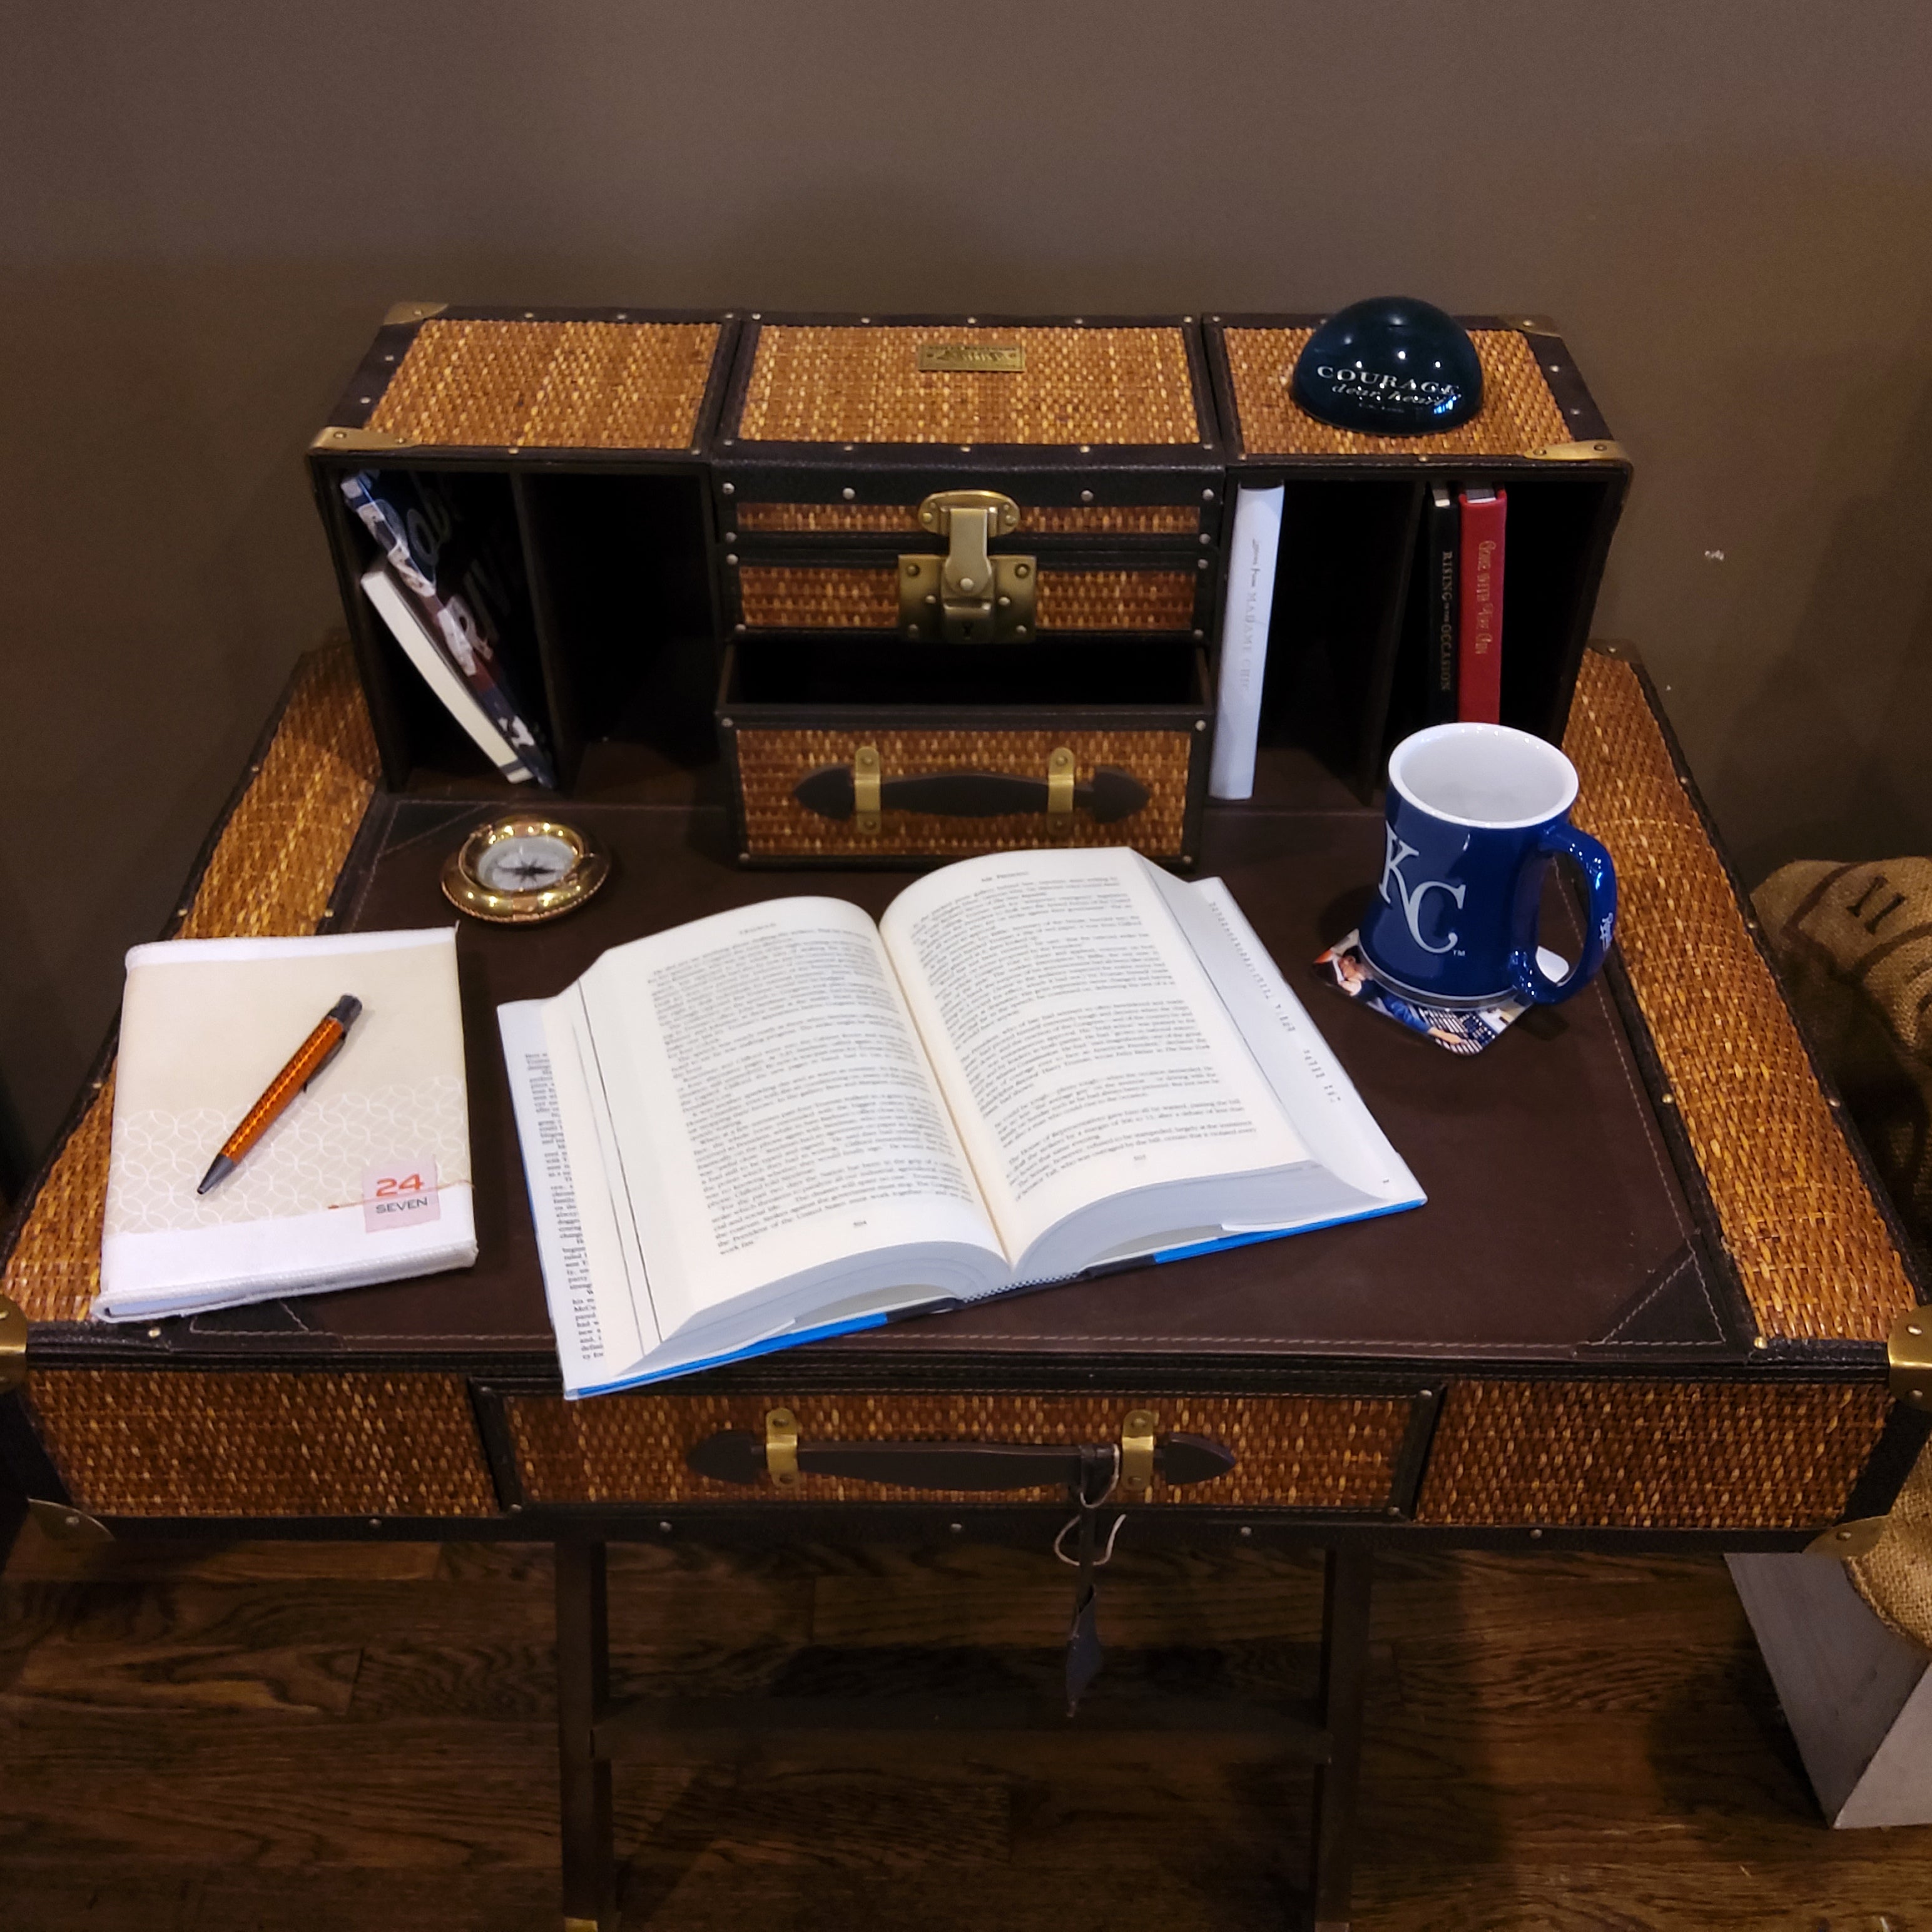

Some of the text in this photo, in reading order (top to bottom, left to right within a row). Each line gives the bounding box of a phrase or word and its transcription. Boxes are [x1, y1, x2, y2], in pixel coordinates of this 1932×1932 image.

[1441, 551, 1453, 601] RISING
[1441, 624, 1452, 691] OCCASION
[377, 1173, 425, 1196] 24
[375, 1197, 429, 1214] SEVEN
